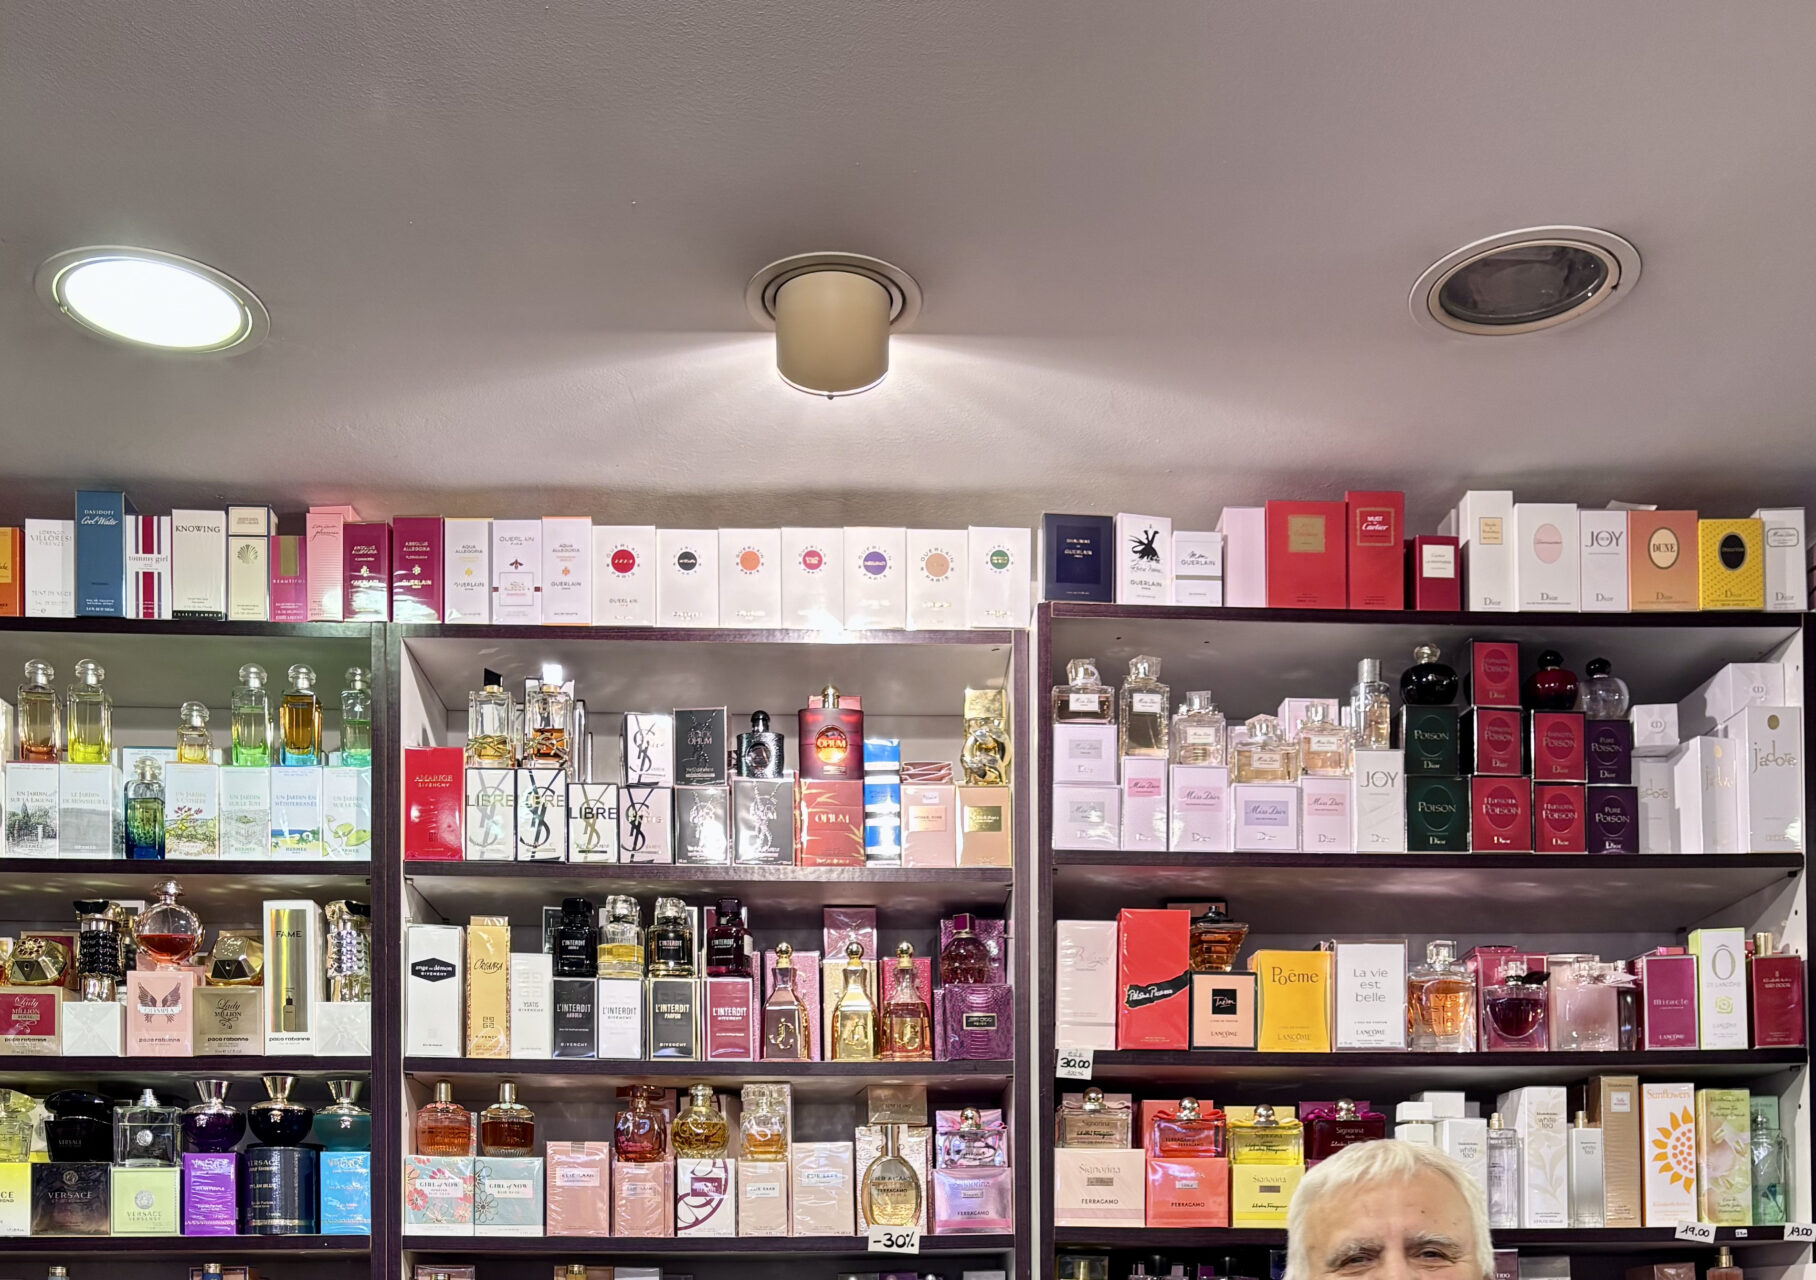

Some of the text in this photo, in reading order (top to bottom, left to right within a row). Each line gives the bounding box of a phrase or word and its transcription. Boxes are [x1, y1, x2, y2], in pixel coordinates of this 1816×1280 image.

[81, 515, 119, 526] Cool Water
[175, 524, 220, 534] KNOWING
[1362, 521, 1389, 531] Cartier
[1585, 530, 1623, 547] JOY
[1653, 543, 1676, 553] DUNE
[129, 554, 169, 564] tommy girl
[1130, 580, 1162, 588] GUERLAIN
[1484, 597, 1501, 606] Dior
[1414, 730, 1449, 740] POISON
[818, 739, 847, 748] OPIUM
[1591, 742, 1623, 753] POISON
[1424, 760, 1440, 769] Dior
[1492, 759, 1508, 768] Dior
[1552, 765, 1569, 773] Dior
[1600, 770, 1616, 778] Dior
[1360, 771, 1398, 788] JOY
[1418, 801, 1456, 812] POISON
[1482, 804, 1521, 815] POISON
[570, 807, 617, 819] LIBRE
[1542, 809, 1577, 820] POISON
[1595, 813, 1630, 824] POISON
[1429, 836, 1446, 845] Dior
[1494, 836, 1511, 844] Dior
[1552, 838, 1569, 846] Dior
[275, 930, 303, 938] FAME
[1712, 943, 1736, 981] Ô
[1272, 967, 1318, 984] Poême
[1353, 968, 1388, 978] La vie
[1360, 980, 1380, 989] est
[14, 995, 39, 1008] Lady
[1355, 992, 1386, 1003] belle
[557, 1003, 591, 1013] L'INTERDIT
[603, 1006, 637, 1016] L'INTERDIT
[656, 1003, 690, 1014] L'INTERDIT
[713, 1007, 747, 1017] L'INTERDIT
[1647, 1089, 1691, 1100] Sunflowers
[1082, 1119, 1110, 1128] Signorina
[1537, 1116, 1556, 1124] white
[1540, 1121, 1553, 1129] tea
[48, 1191, 93, 1200] VERSACE
[1681, 1225, 1709, 1237] 19.00
[873, 1232, 915, 1248] -30%
